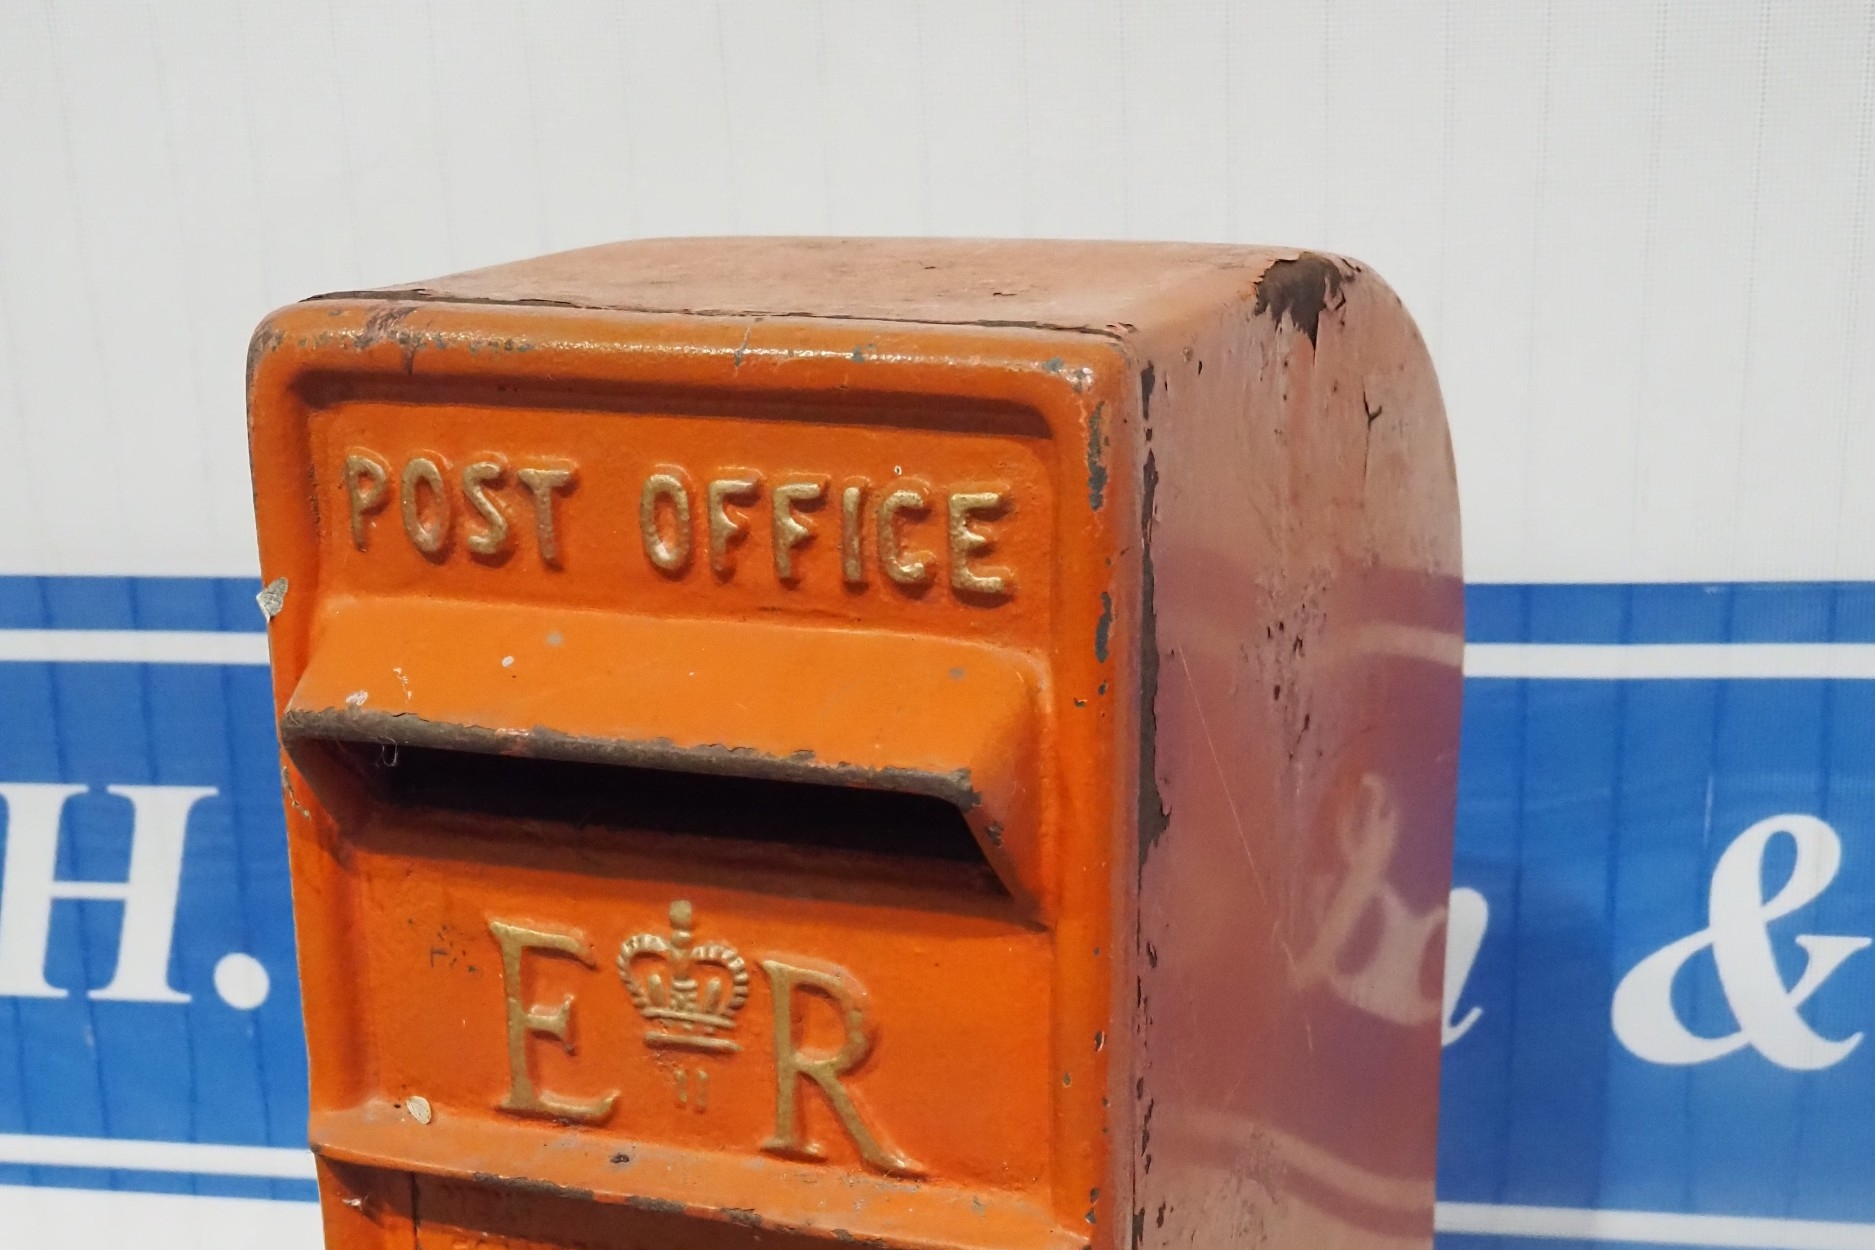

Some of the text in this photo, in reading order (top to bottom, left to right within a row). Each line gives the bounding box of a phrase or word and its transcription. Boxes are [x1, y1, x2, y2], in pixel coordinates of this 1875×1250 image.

[345, 454, 1010, 594] POST OFFICE
[1611, 813, 1872, 1071] &
